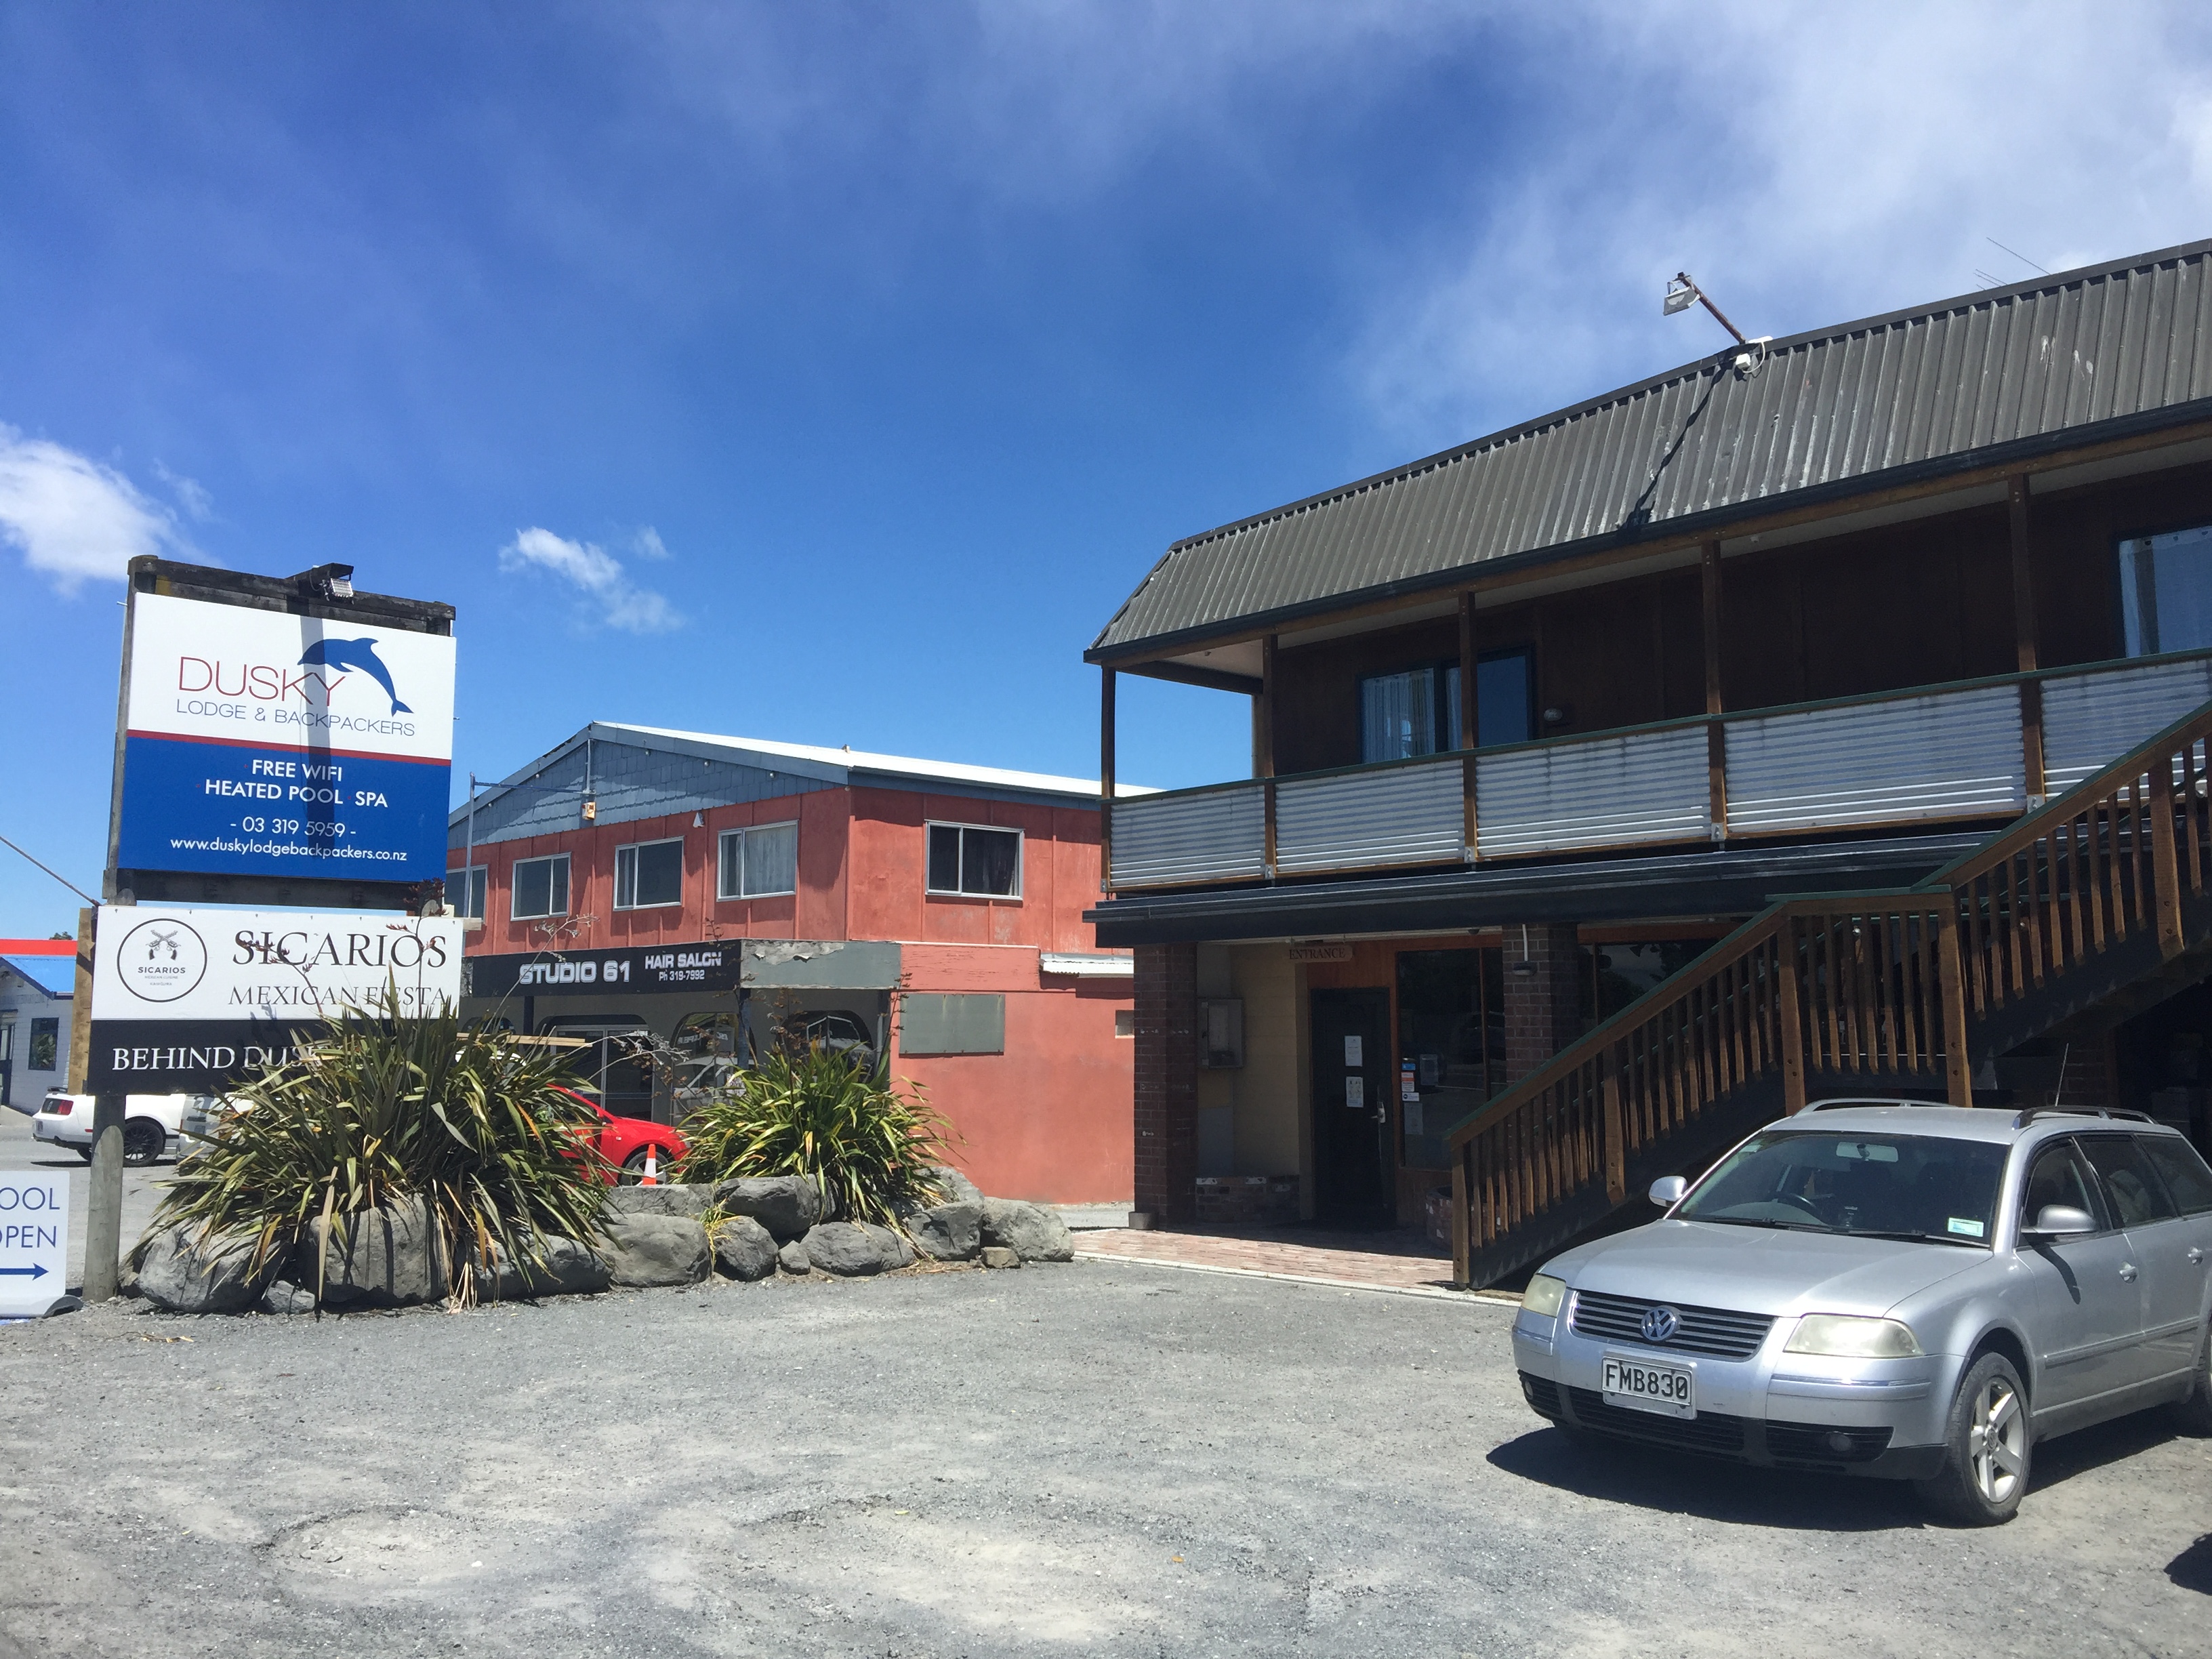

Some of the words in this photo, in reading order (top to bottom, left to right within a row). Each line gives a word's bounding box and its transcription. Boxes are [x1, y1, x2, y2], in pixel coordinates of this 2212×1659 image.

[179, 656, 346, 707] DUSKY
[176, 699, 247, 720] LODGE
[254, 707, 266, 722] &
[274, 709, 415, 737] BACKPACKERS
[252, 759, 296, 778] FREE
[302, 763, 342, 781] WIFI
[205, 779, 282, 800] HEATED
[289, 785, 344, 804] POOL
[354, 790, 388, 808] SPA
[243, 816, 265, 833] 03
[272, 818, 300, 835] 319
[304, 821, 346, 838] 5959
[170, 837, 407, 861] www.duskylodgebackpackers.co.nz
[232, 930, 447, 967] SICARIOS
[1289, 948, 1346, 960] ENTRANCE
[519, 961, 596, 985] STUDIO
[603, 960, 630, 983] 61
[644, 954, 674, 970] HAIR
[659, 969, 668, 981] Ph
[669, 970, 705, 981] 319-7992
[228, 985, 358, 1005] MEXICAN
[112, 1046, 235, 1071] BEHIND
[243, 1046, 344, 1069] DUSK
[0, 1225, 57, 1248] PEN
[1605, 1364, 1688, 1400] FMB830
